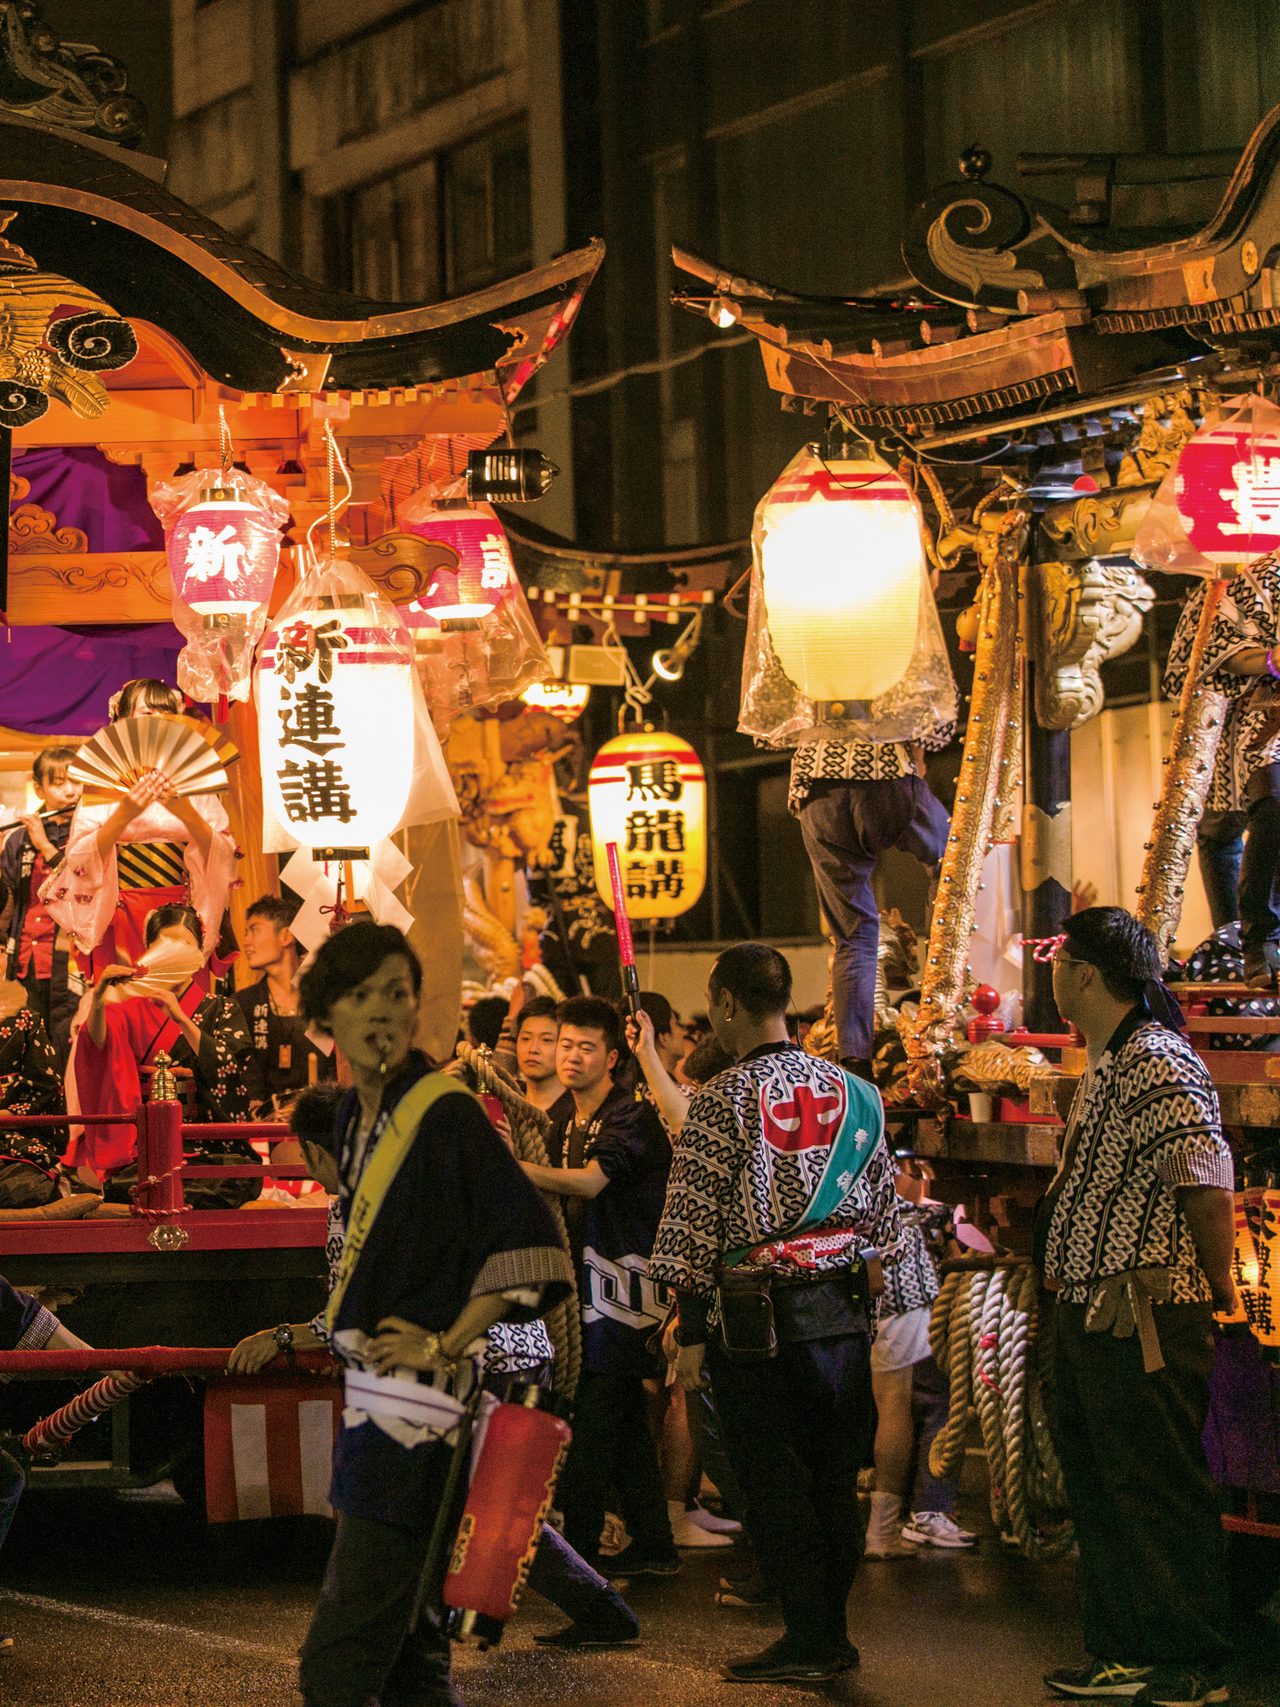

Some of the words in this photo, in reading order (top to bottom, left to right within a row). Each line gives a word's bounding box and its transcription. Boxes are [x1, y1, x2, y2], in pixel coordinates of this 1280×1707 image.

[185, 525, 245, 581] 新
[274, 619, 357, 824] 新連講
[625, 759, 685, 898] 馬龍講
